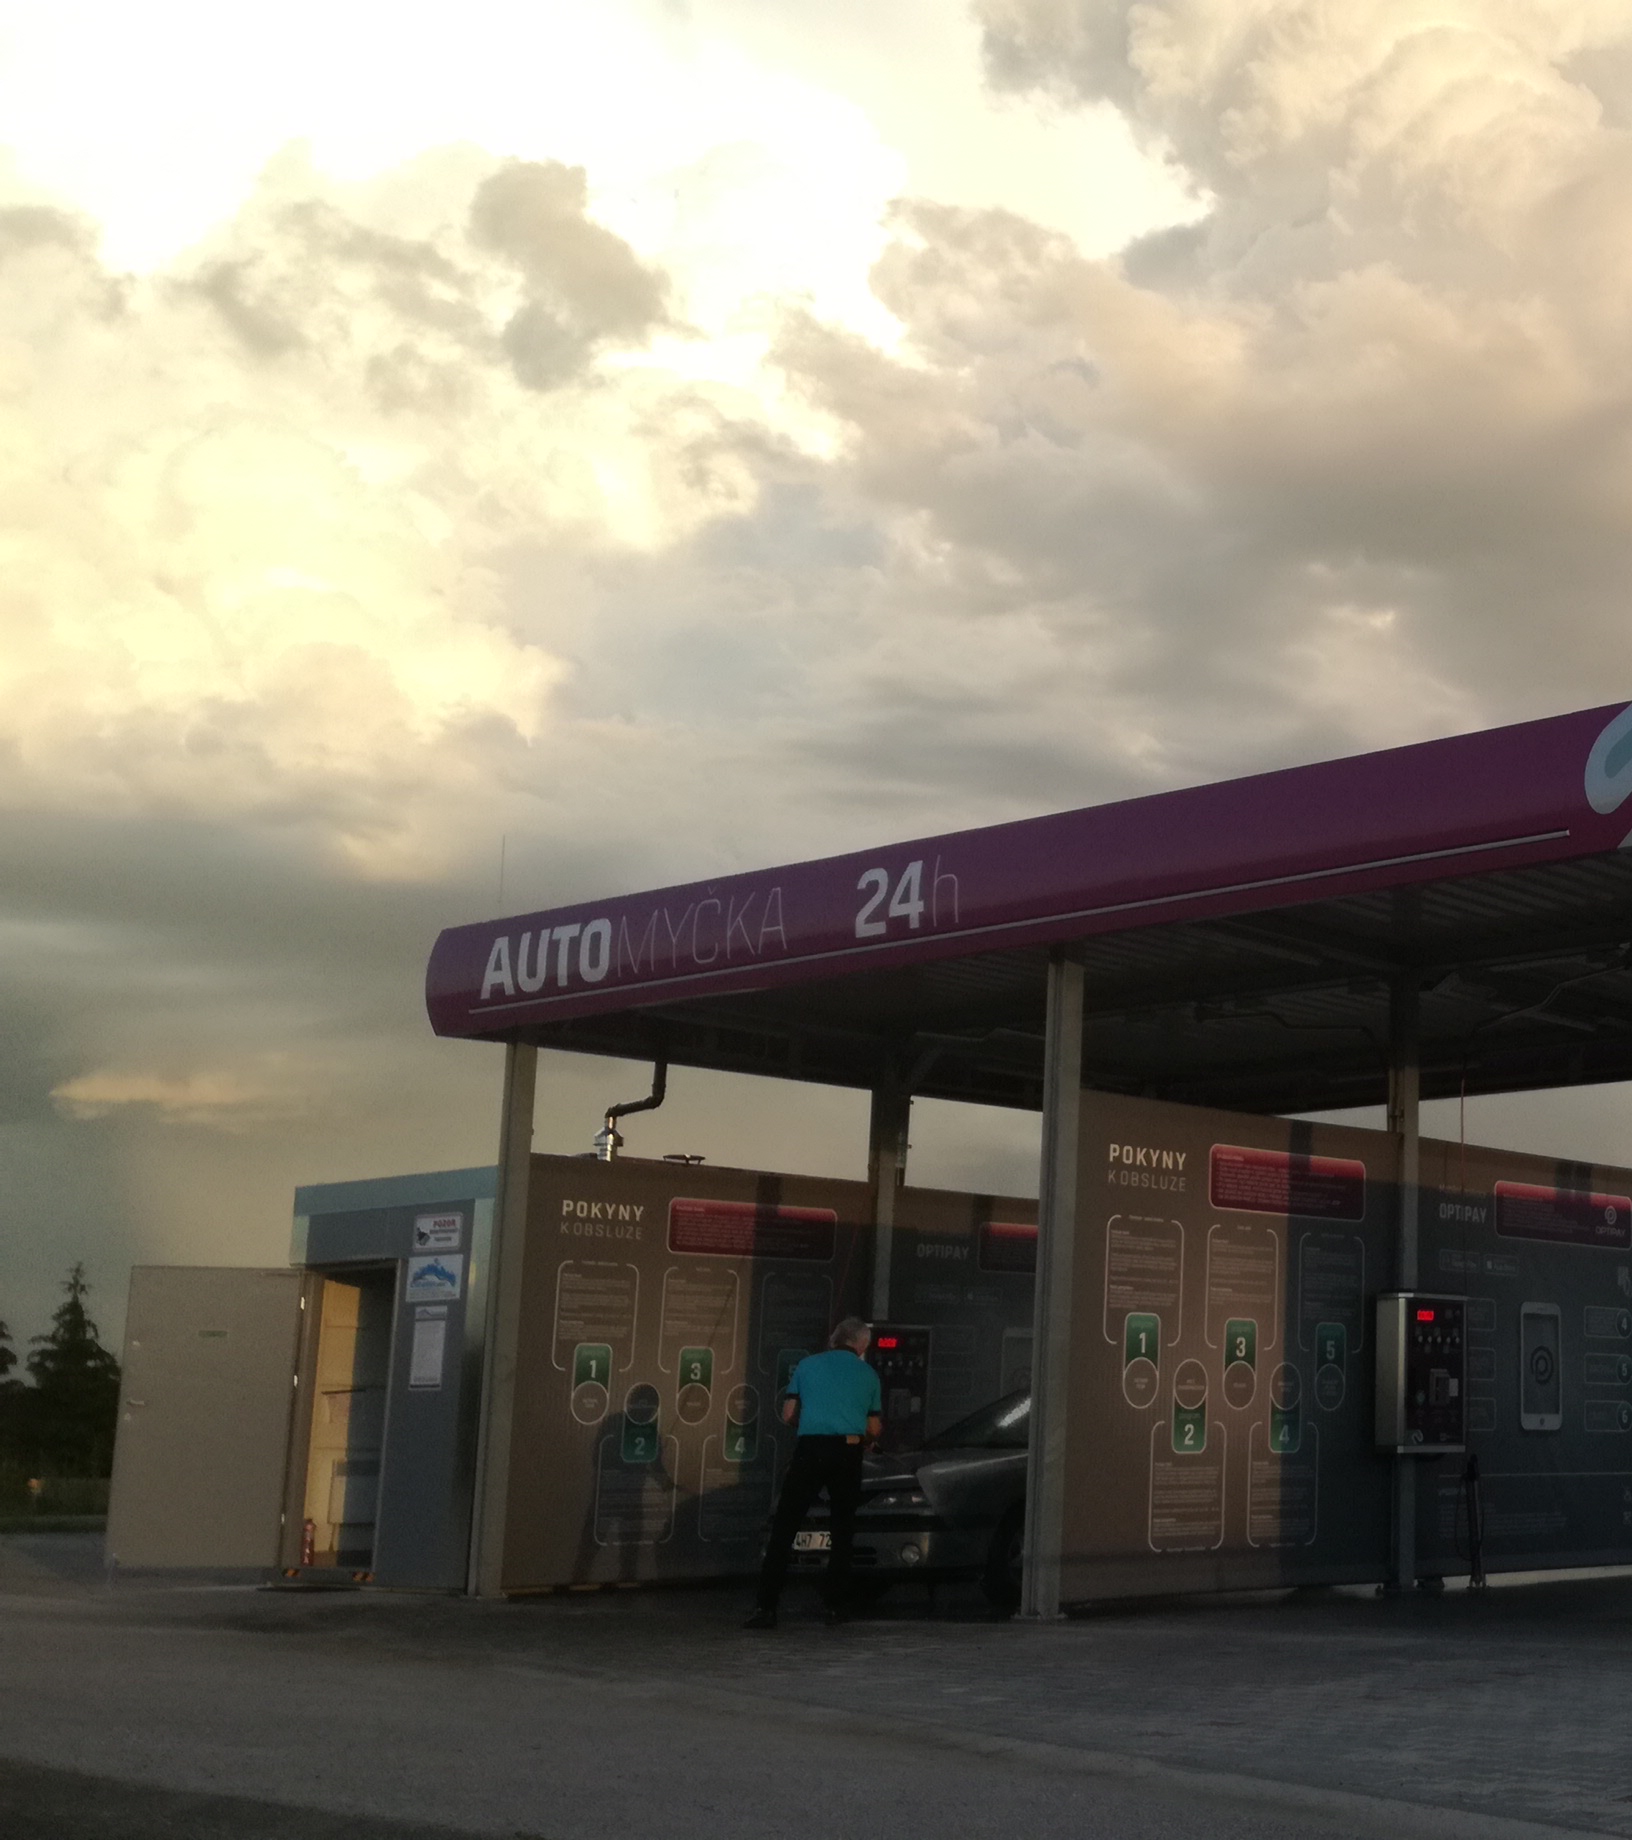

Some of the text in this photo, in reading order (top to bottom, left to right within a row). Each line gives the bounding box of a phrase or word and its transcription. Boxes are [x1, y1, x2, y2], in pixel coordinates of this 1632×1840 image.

[480, 854, 960, 1000] AUTOMYČKA 24h
[1108, 1143, 1187, 1171] POKYNY
[561, 1199, 645, 1222] POKYNY
[1439, 1202, 1488, 1224] OPTIPAY
[1595, 1225, 1626, 1237] OPTIPAY
[916, 1243, 970, 1260] OPTIPAY
[1139, 1332, 1146, 1354] 1
[1236, 1337, 1246, 1357] 3
[1326, 1340, 1335, 1360] 5
[589, 1359, 597, 1379] 1
[690, 1362, 701, 1380] 3
[1184, 1424, 1194, 1445] 2
[1279, 1425, 1290, 1444] 4
[634, 1437, 646, 1456] 2
[734, 1437, 745, 1454] 4
